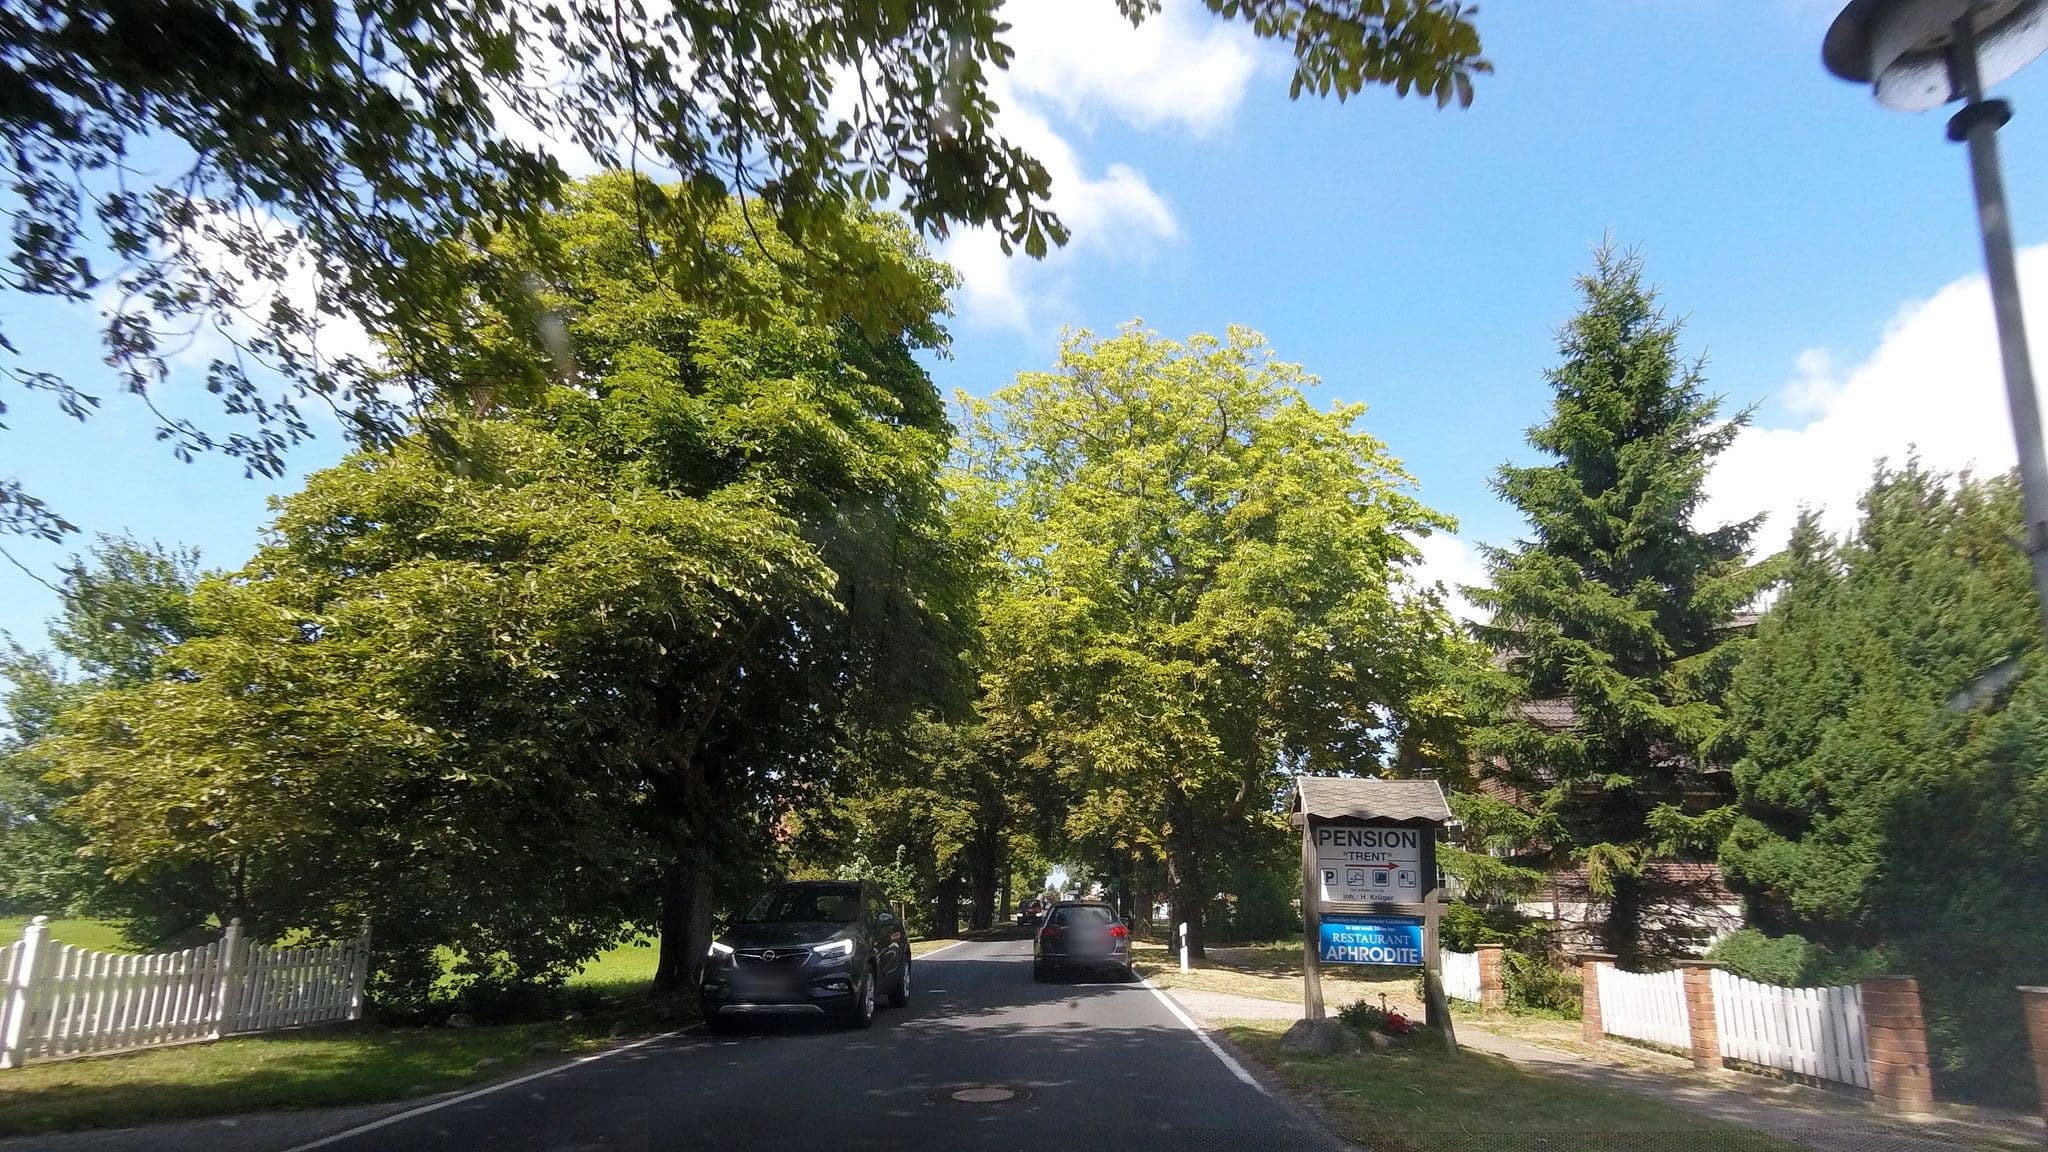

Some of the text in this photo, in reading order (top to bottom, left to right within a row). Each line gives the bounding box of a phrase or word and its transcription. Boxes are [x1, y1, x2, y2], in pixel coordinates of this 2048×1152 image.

[1318, 829, 1417, 848] PENSION
[1325, 870, 1334, 883] P
[1332, 932, 1411, 945] RESTAURANT
[1326, 945, 1418, 963] APHRODITE
